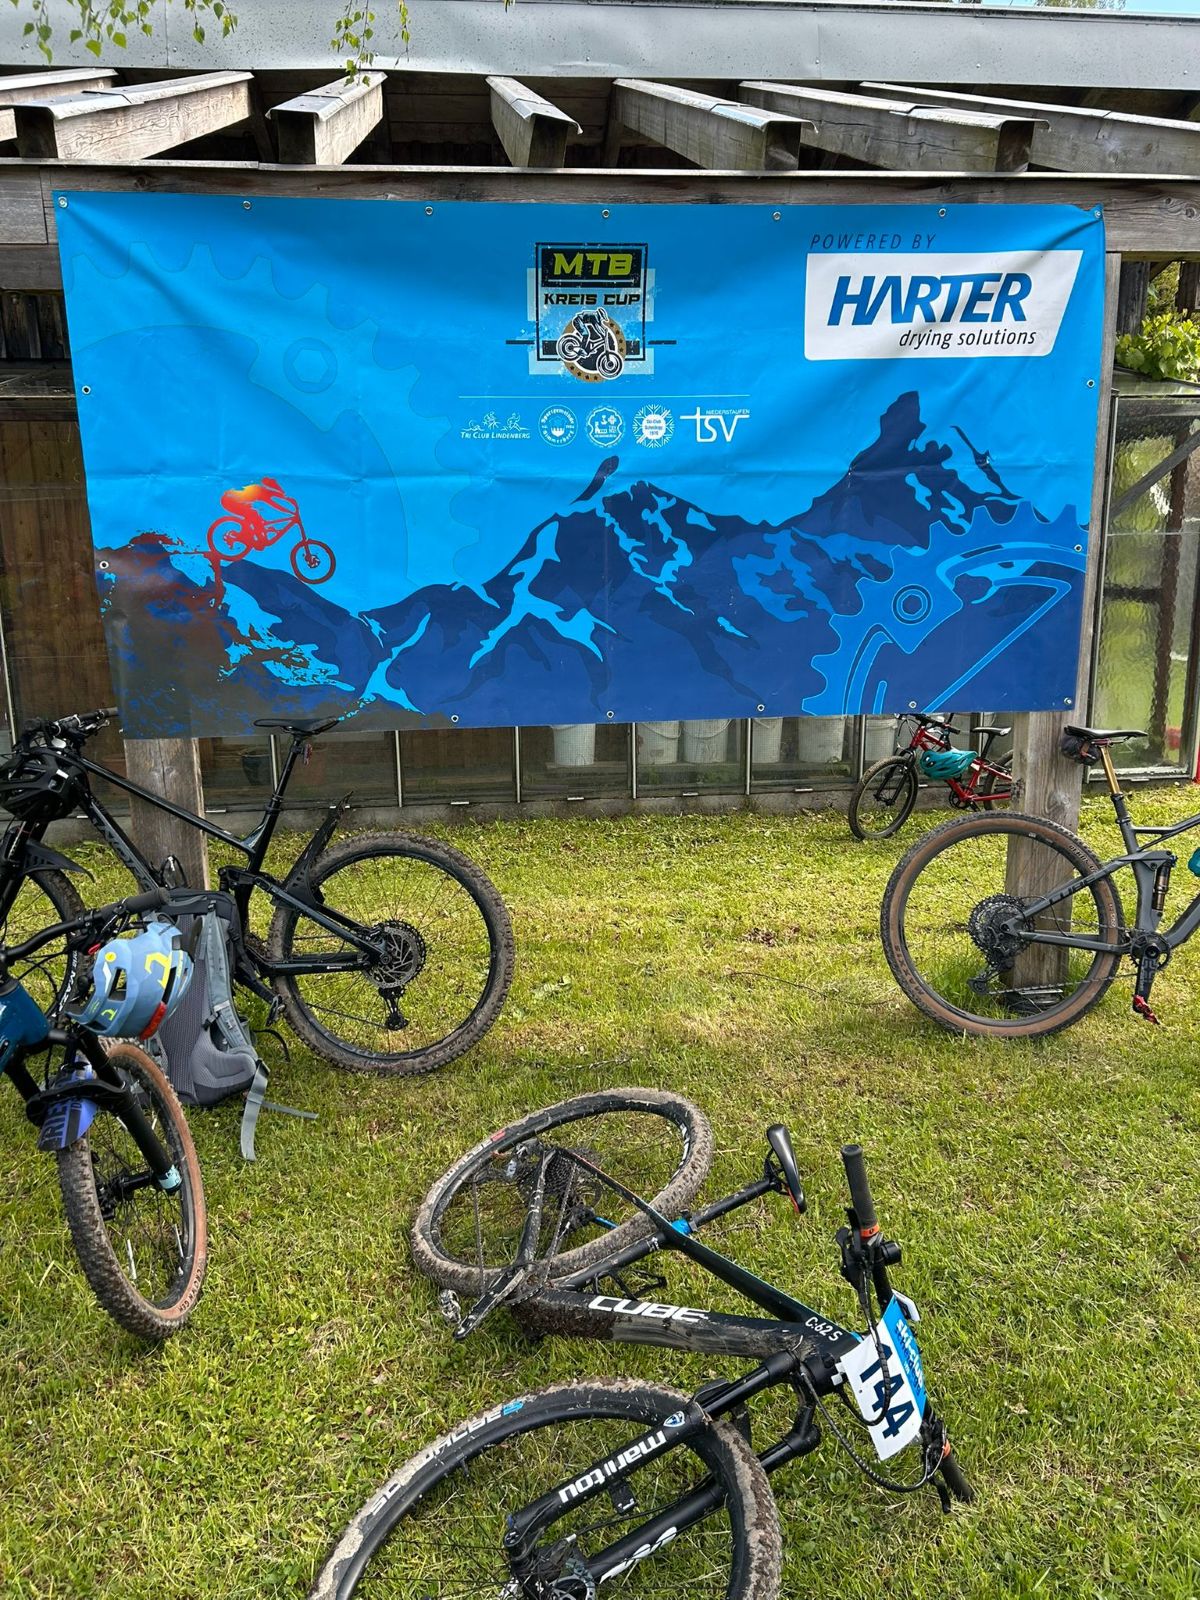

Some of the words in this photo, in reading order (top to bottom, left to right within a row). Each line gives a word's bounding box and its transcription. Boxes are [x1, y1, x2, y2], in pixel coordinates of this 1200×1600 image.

[810, 233, 902, 249] POWERED
[912, 233, 937, 249] BY
[552, 252, 634, 276] MTB
[543, 293, 598, 306] KREIS
[603, 292, 641, 306] CUP
[827, 272, 1033, 326] HARTER
[898, 329, 952, 350] drying
[957, 328, 1037, 346] solutions
[460, 431, 471, 439] TRI
[472, 431, 490, 439] CLUB
[491, 431, 531, 439] LINDENBERG
[588, 1295, 708, 1323] CUBE
[804, 1316, 834, 1337] C:62
[829, 1330, 844, 1342] S
[859, 1343, 915, 1440] 144
[558, 1430, 667, 1504] manitou
